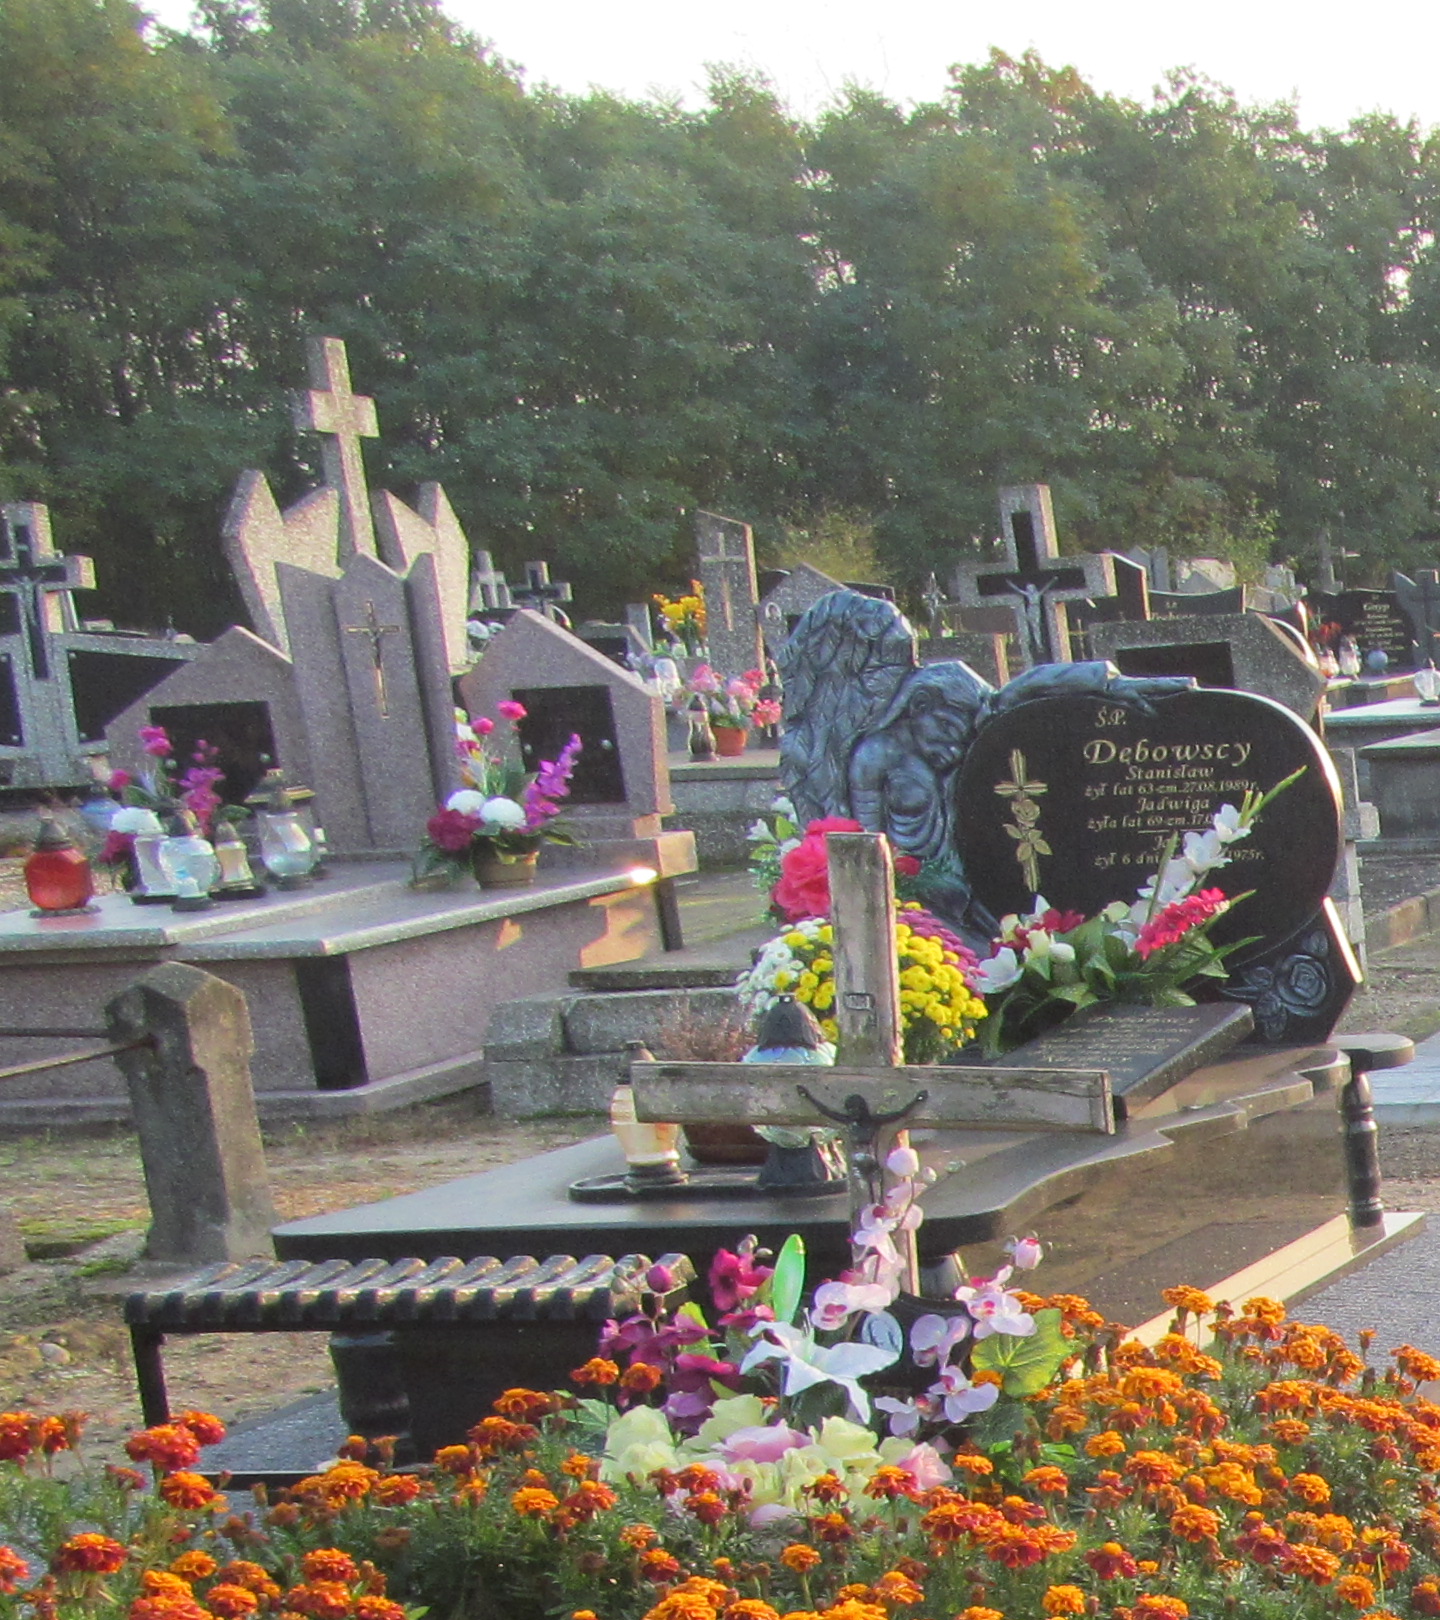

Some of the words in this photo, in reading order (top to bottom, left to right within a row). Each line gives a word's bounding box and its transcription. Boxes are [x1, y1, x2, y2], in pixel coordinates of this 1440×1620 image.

[1095, 705, 1127, 727] Ś.P.
[1083, 738, 1251, 767] Dębowscy
[1125, 763, 1214, 780] Stanisław
[1113, 783, 1132, 795] lat
[1136, 798, 1210, 814] Jadwiga
[1122, 815, 1141, 828] lat
[1122, 854, 1130, 864] 6
